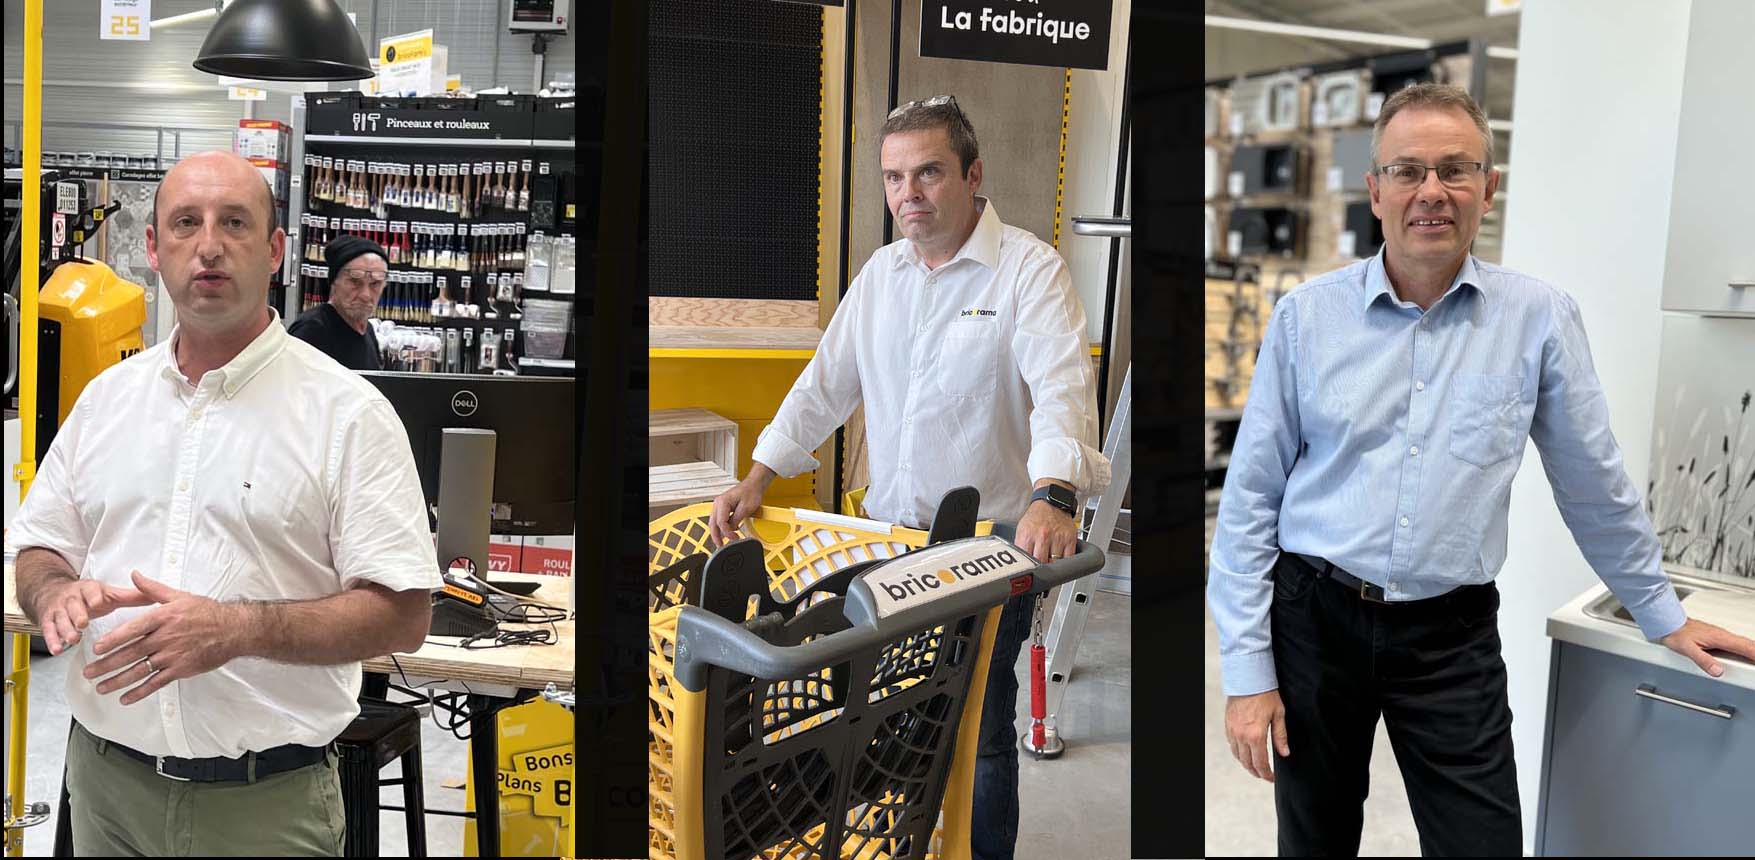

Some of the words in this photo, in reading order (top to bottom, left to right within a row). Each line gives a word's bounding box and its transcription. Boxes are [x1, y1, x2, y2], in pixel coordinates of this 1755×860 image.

[112, 16, 139, 35] 25
[941, 5, 972, 31] La
[979, 7, 1091, 44] fabrique
[386, 117, 433, 129] Pinceaux
[433, 119, 445, 129] et
[445, 118, 490, 130] rouleaux
[454, 399, 475, 408] DELL
[879, 549, 1018, 602] bricorama
[525, 752, 573, 771] Bons
[496, 772, 542, 793] Plans
